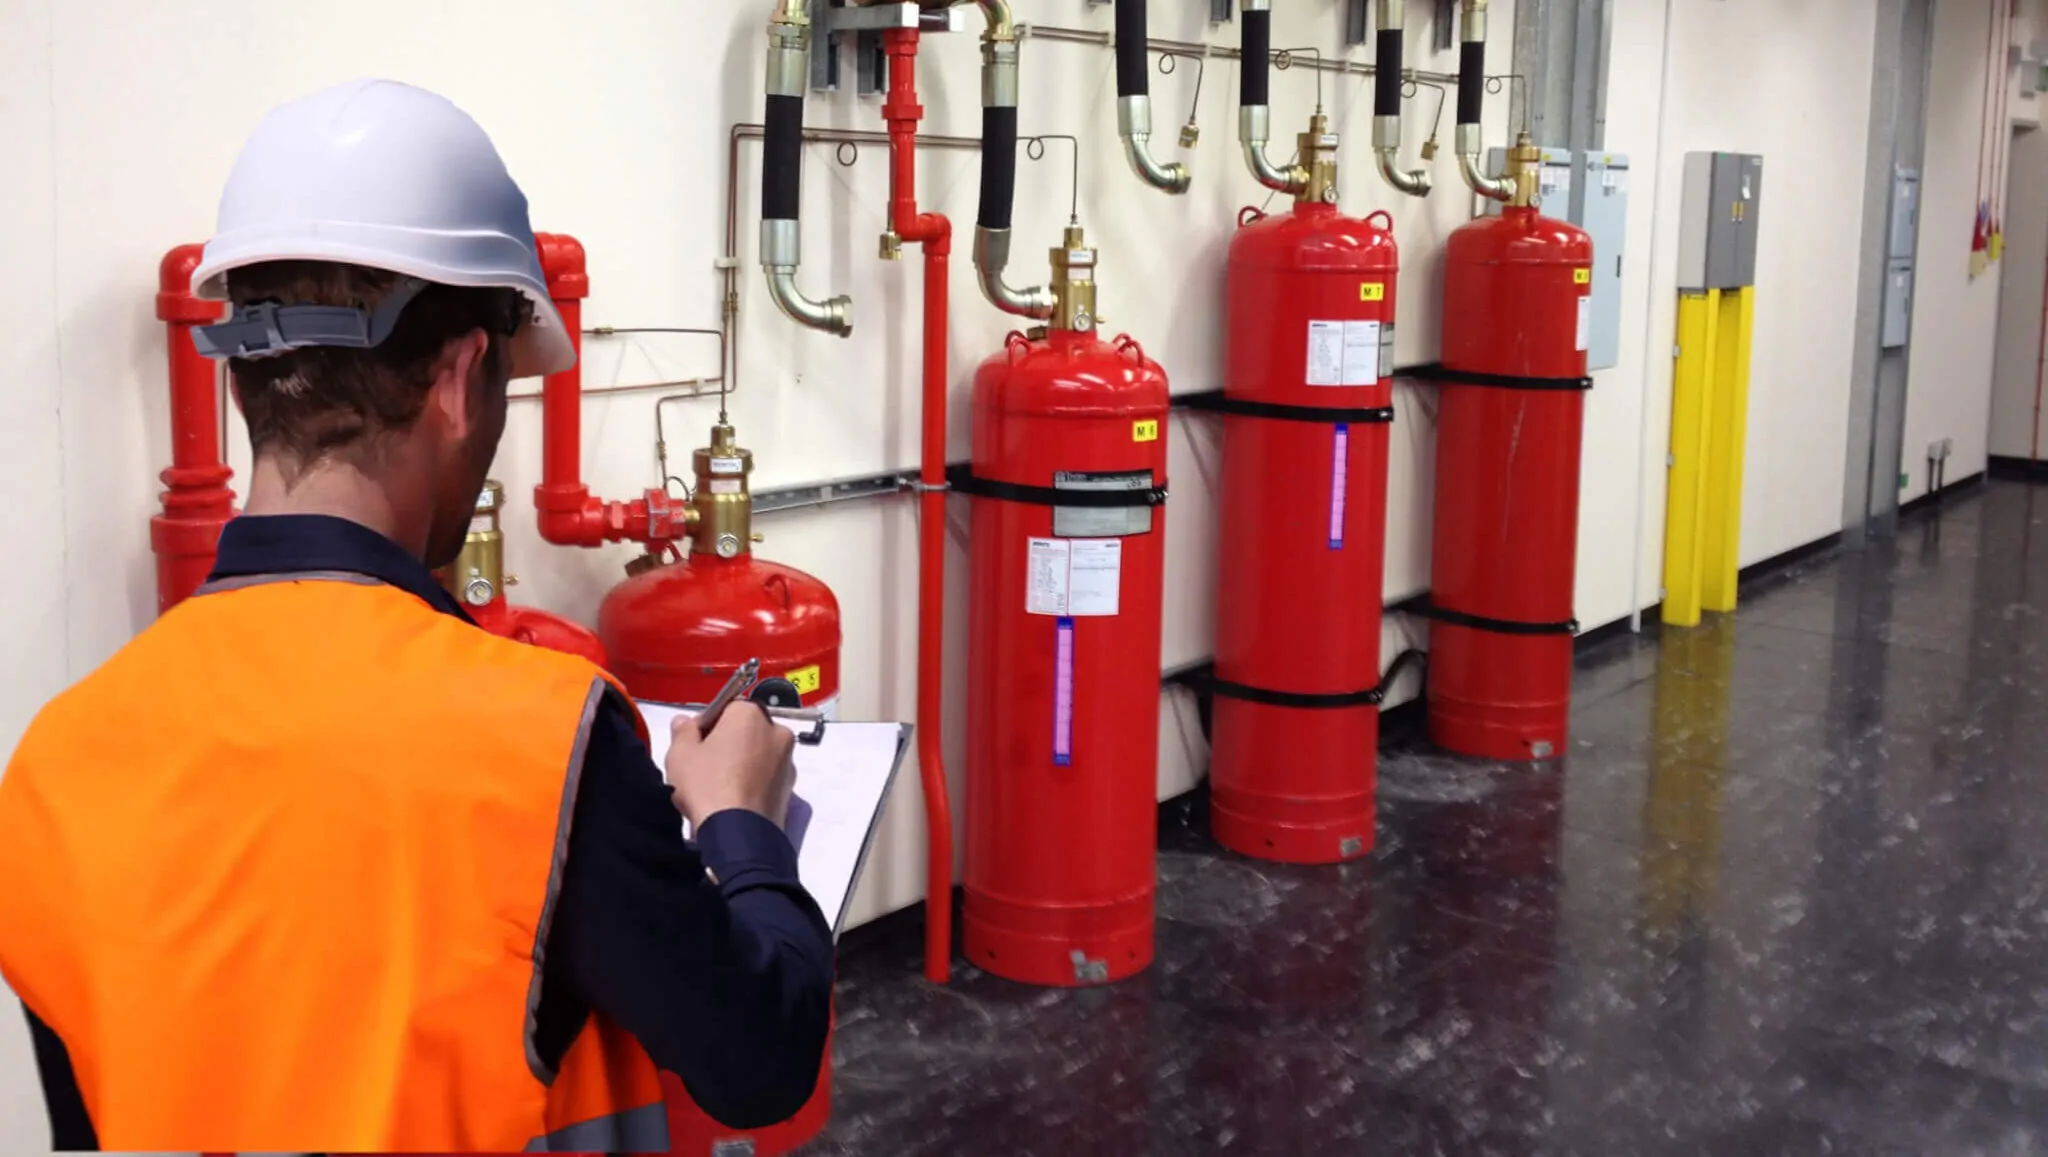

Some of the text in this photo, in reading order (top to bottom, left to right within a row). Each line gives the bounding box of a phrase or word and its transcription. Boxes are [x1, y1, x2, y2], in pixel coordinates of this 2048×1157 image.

[1363, 287, 1372, 297] M
[1137, 426, 1146, 437] M
[808, 671, 817, 686] 5
